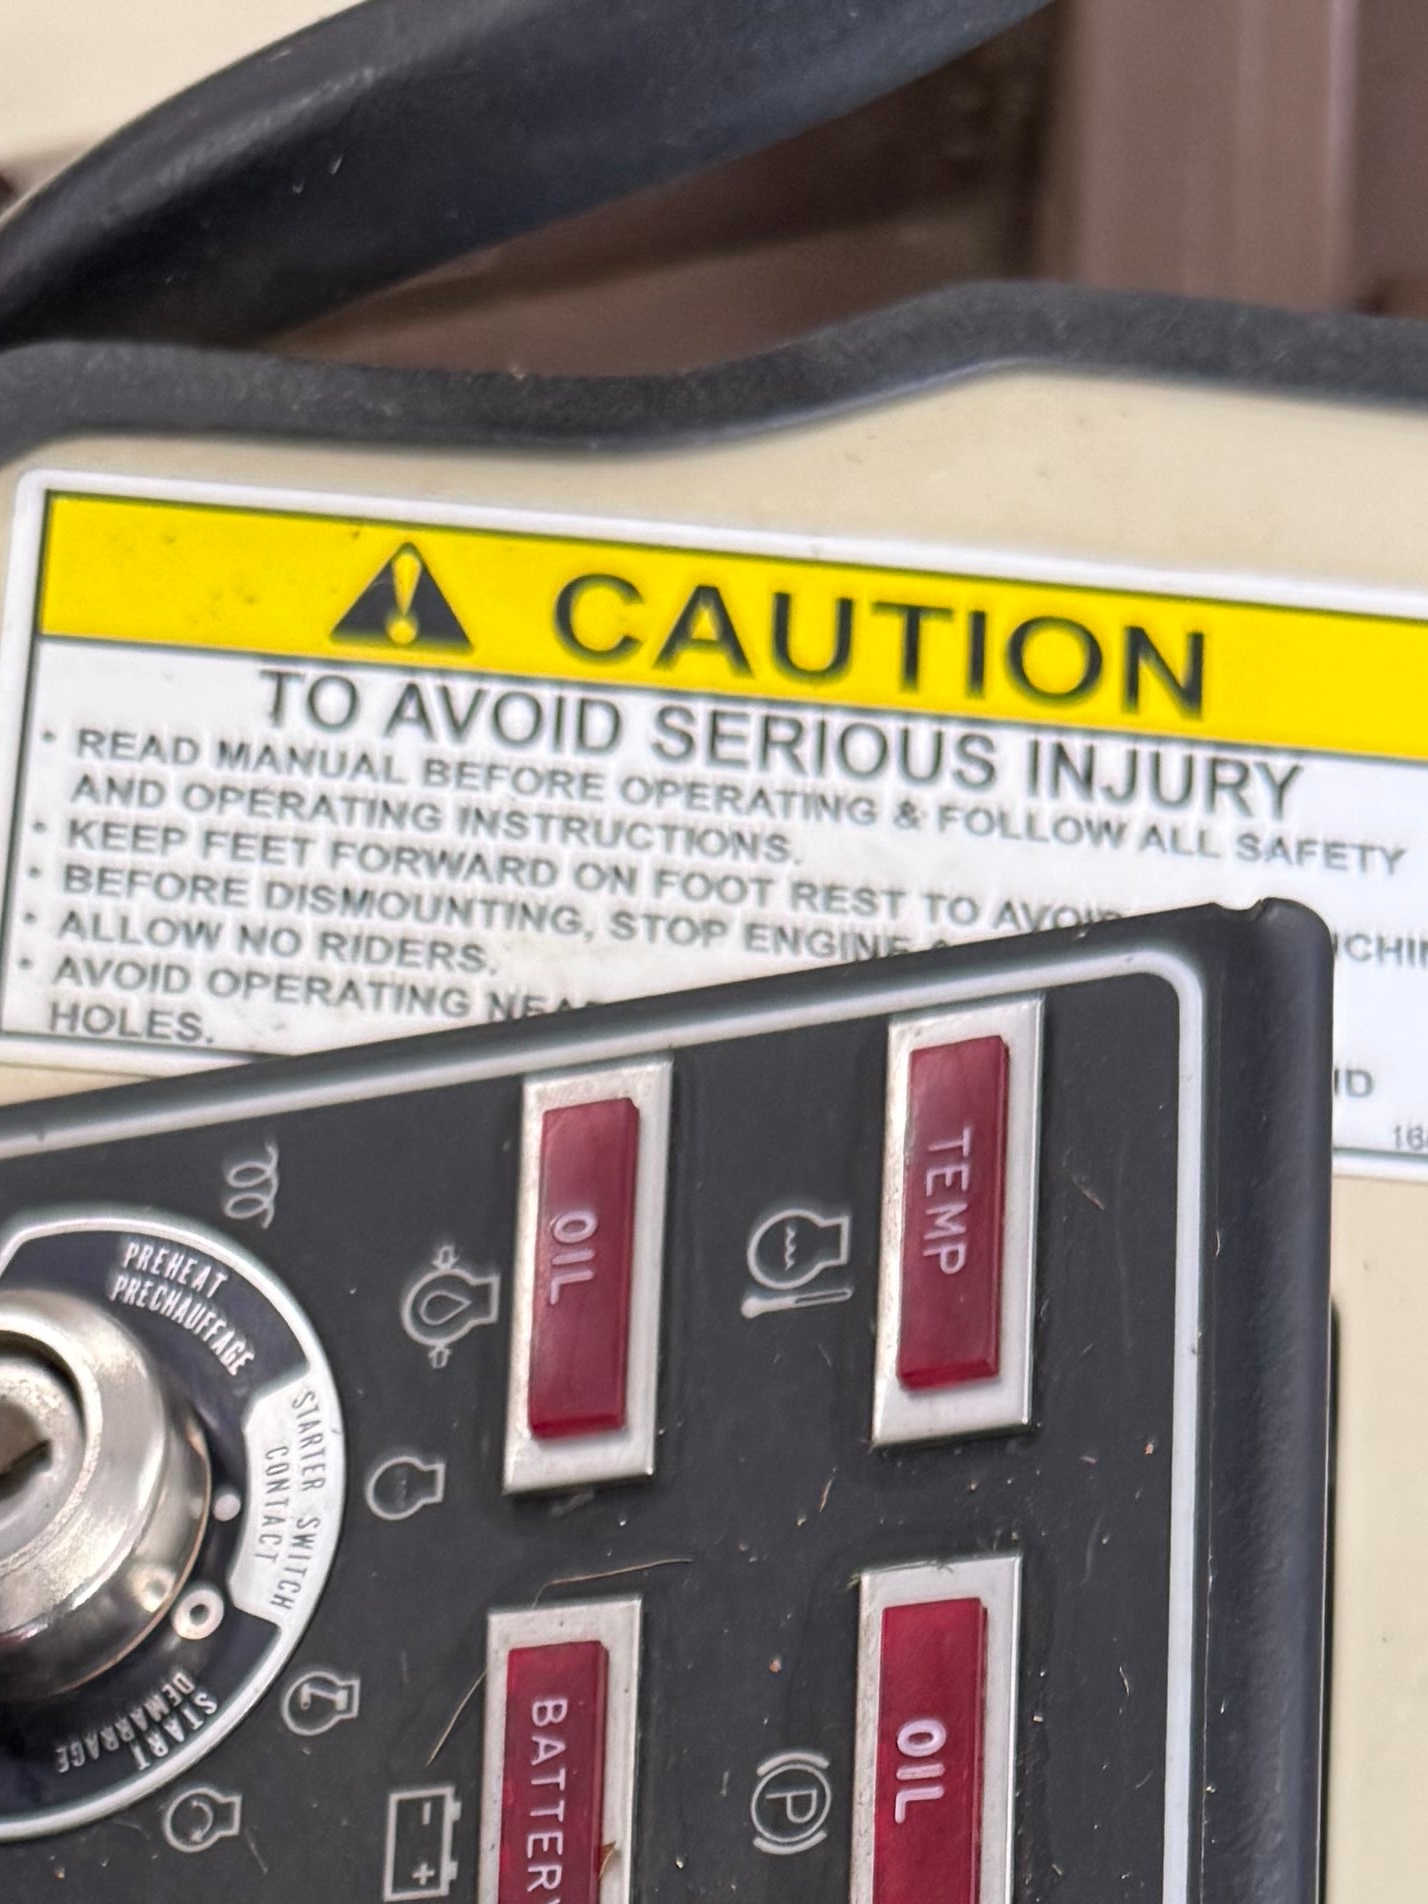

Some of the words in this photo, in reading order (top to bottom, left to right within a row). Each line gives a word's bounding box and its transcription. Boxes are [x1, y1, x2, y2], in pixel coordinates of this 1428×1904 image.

[554, 573, 1207, 719] CAUTION
[260, 669, 361, 731] TO
[383, 682, 622, 754] AVOID
[652, 706, 994, 790] SERIOUS
[1029, 738, 1303, 821] INJURY
[72, 775, 166, 809] AND
[182, 783, 442, 833] OPERATING
[459, 806, 800, 865] INSTRUCTIONS.
[77, 728, 200, 765] READ
[217, 741, 407, 785] MANUAL
[423, 758, 604, 800] BEFORE
[620, 776, 876, 826] OPERATING
[894, 802, 921, 829] &
[938, 807, 1125, 849] FOLLOW
[1139, 824, 1219, 859] ALL
[1237, 833, 1407, 876] SAFETY
[64, 864, 248, 907] BEFORE
[266, 880, 594, 943] DISMOUNTING,
[610, 911, 728, 947] STOP
[745, 921, 911, 961] ENGINE
[67, 820, 187, 854] KEEP
[203, 831, 315, 867] FEET
[330, 840, 556, 889] FORWARD
[574, 863, 639, 895] ON
[654, 868, 776, 909] FOOT
[791, 880, 907, 918] REST
[923, 894, 979, 925] TO
[992, 901, 1122, 932] AVO
[54, 957, 191, 994] AVOID
[208, 968, 469, 1018] OPERATING
[57, 911, 222, 950] ALLOW
[238, 925, 301, 958] NO
[319, 932, 497, 976] RIDERS.
[49, 1001, 213, 1044] HOLES.
[921, 1126, 971, 1275] TEMP
[121, 1241, 229, 1295] PREHEAT
[549, 1209, 599, 1305] OIL
[109, 1274, 255, 1375] PRECHAUFFAGE
[292, 1389, 328, 1494] STARTER
[254, 1445, 290, 1562] CONTACT
[276, 1517, 321, 1611] SWITCH
[54, 1670, 194, 1774] DEMARRAGE
[132, 1689, 218, 1772] START
[893, 1719, 948, 1824] OIL
